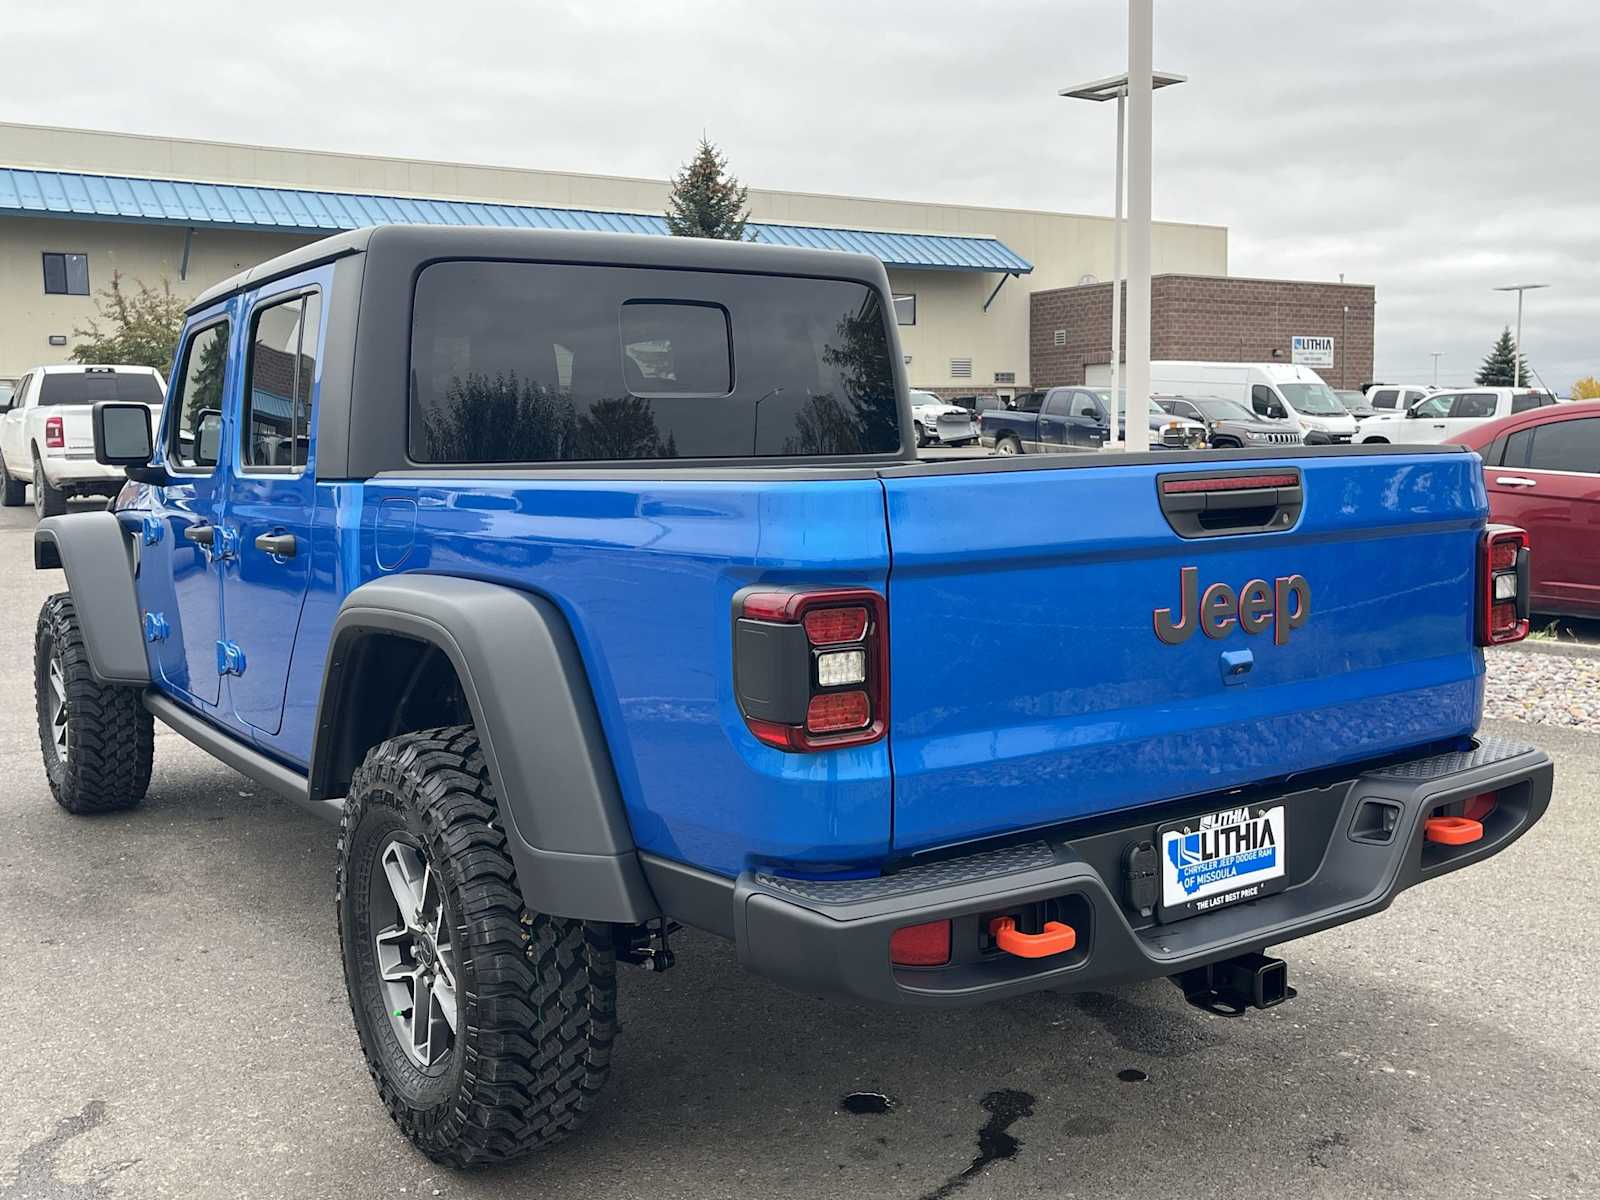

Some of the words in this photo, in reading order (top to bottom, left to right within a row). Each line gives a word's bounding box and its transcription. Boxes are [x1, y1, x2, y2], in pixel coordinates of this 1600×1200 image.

[1302, 338, 1331, 350] LITHIA
[1154, 566, 1311, 646] Jeep
[1211, 807, 1250, 827] LITHIA
[1201, 818, 1275, 861] LITHIA
[1184, 860, 1218, 876] CHRYSLER
[1219, 855, 1235, 867] JEEP
[1236, 851, 1257, 863] DODGE
[1258, 847, 1272, 859] RAM
[1184, 876, 1196, 888] OF
[1197, 865, 1237, 885] MISSOULA
[1196, 899, 1209, 910] THE
[1210, 895, 1225, 907] LAST
[1225, 892, 1240, 903] BEST
[1241, 886, 1258, 898] PRICE
